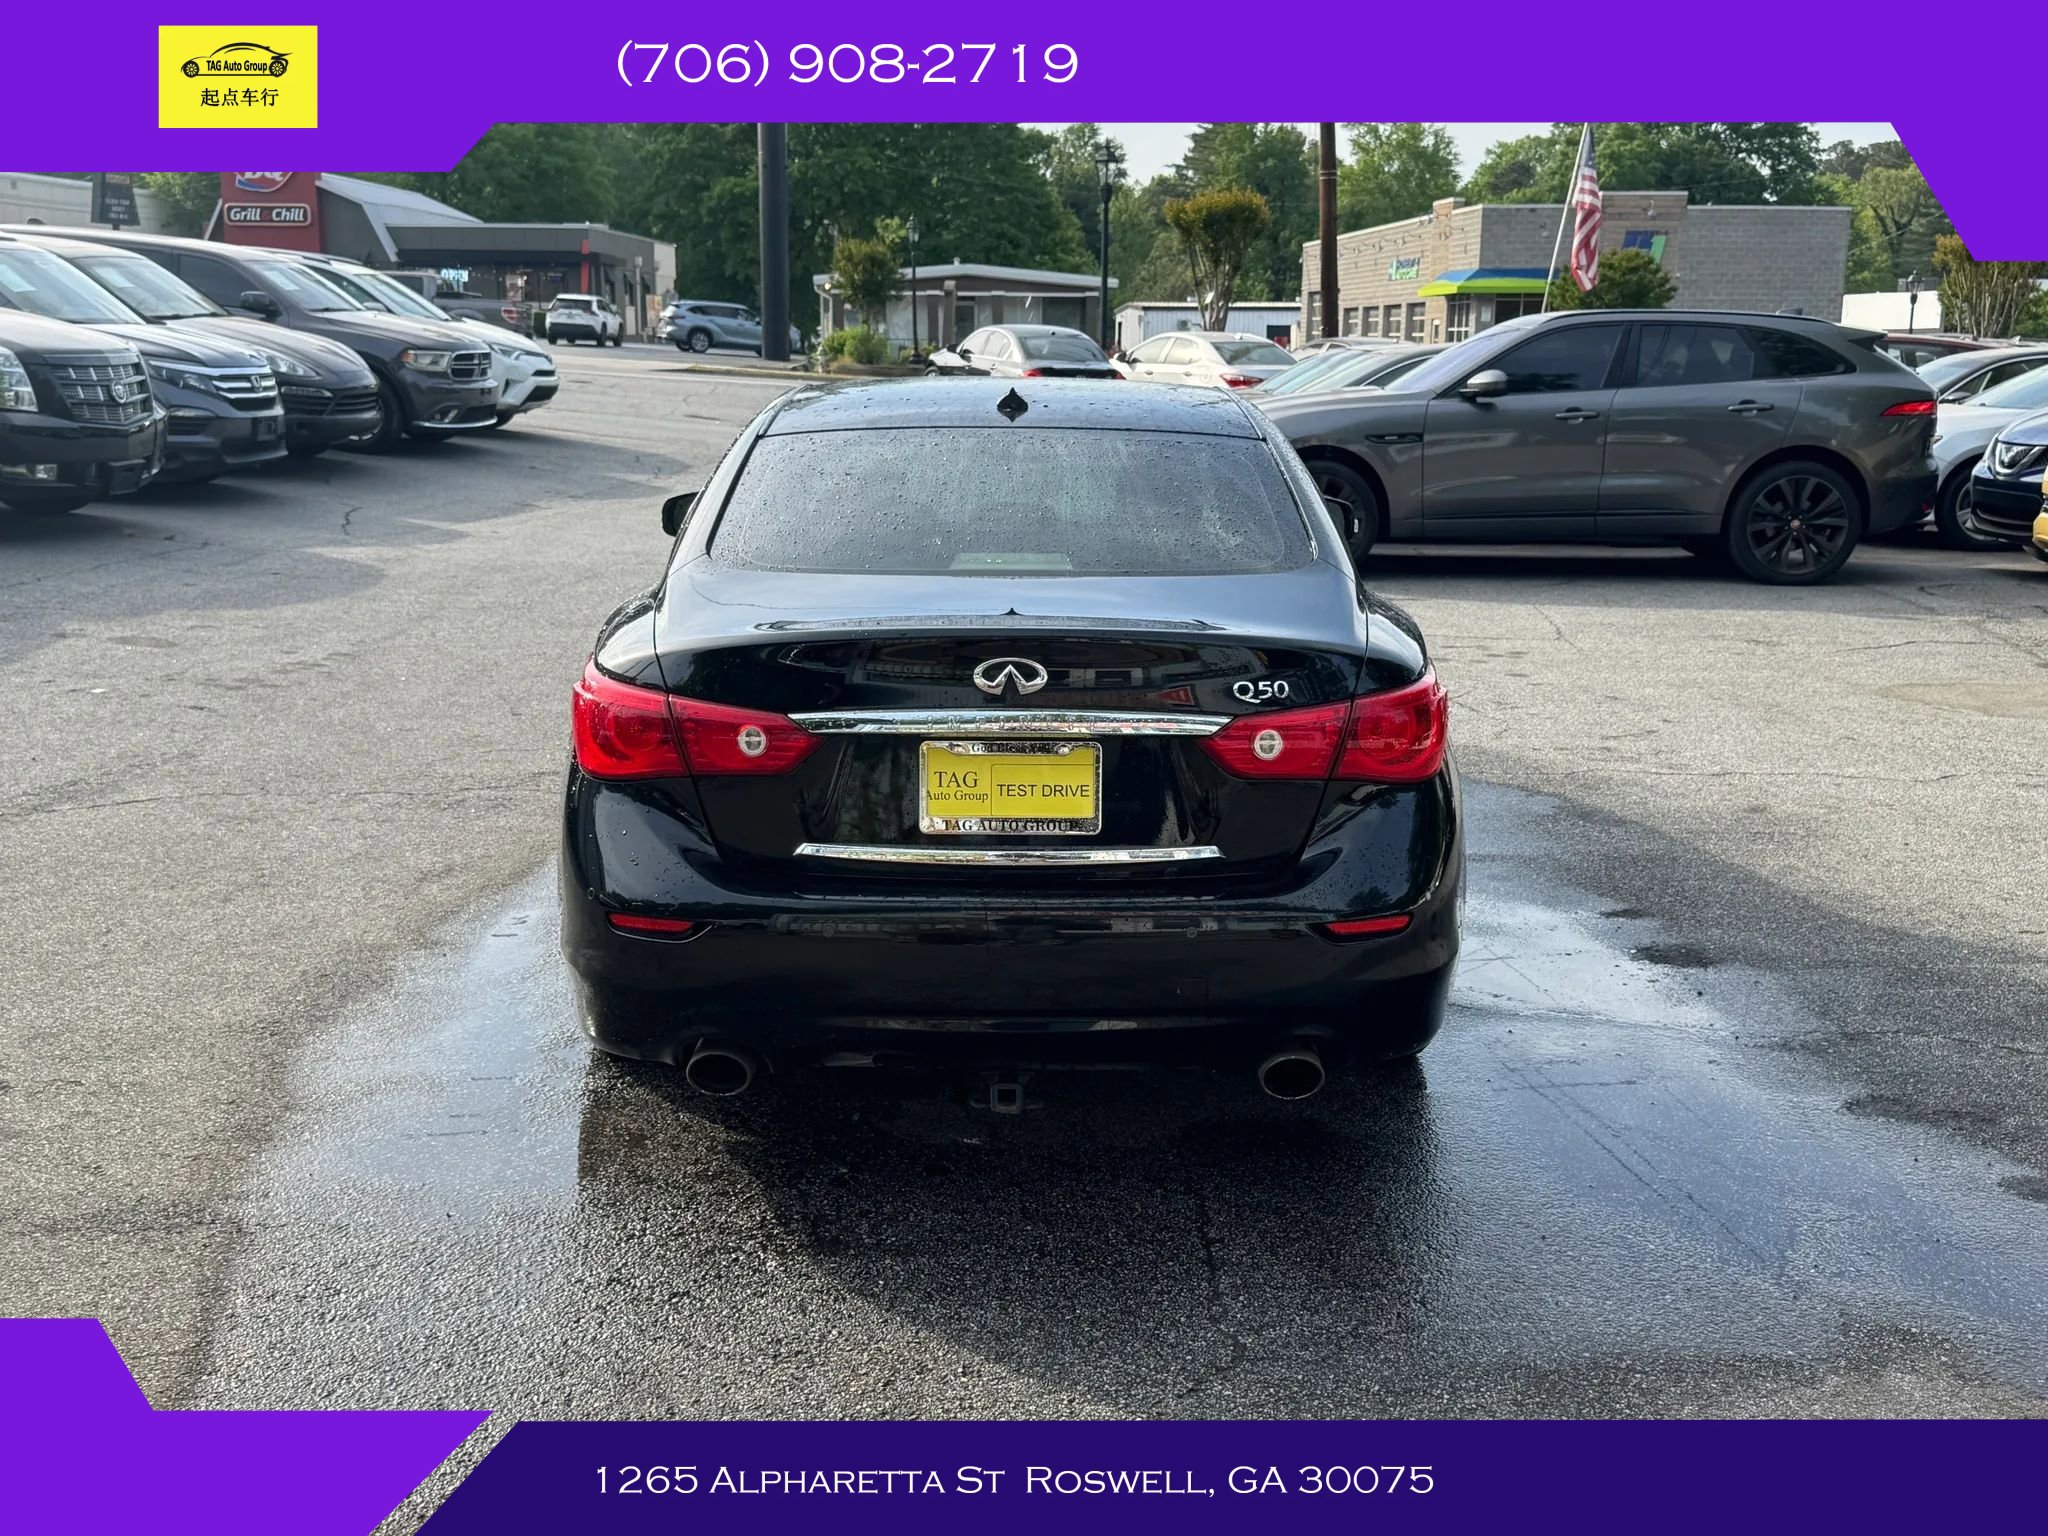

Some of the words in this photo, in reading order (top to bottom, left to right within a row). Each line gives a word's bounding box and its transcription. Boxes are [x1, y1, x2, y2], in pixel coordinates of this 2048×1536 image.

[230, 208, 261, 221] Grill
[271, 208, 304, 221] Chill
[1232, 680, 1290, 704] Q50
[934, 771, 979, 788] TAG
[927, 790, 951, 801] Auto
[953, 790, 989, 803] Group
[997, 784, 1037, 797] TEST
[1042, 784, 1090, 797] DRIVE
[942, 819, 972, 831] TAG
[977, 819, 1019, 832] AUTO
[1024, 819, 1078, 832] GROUP
